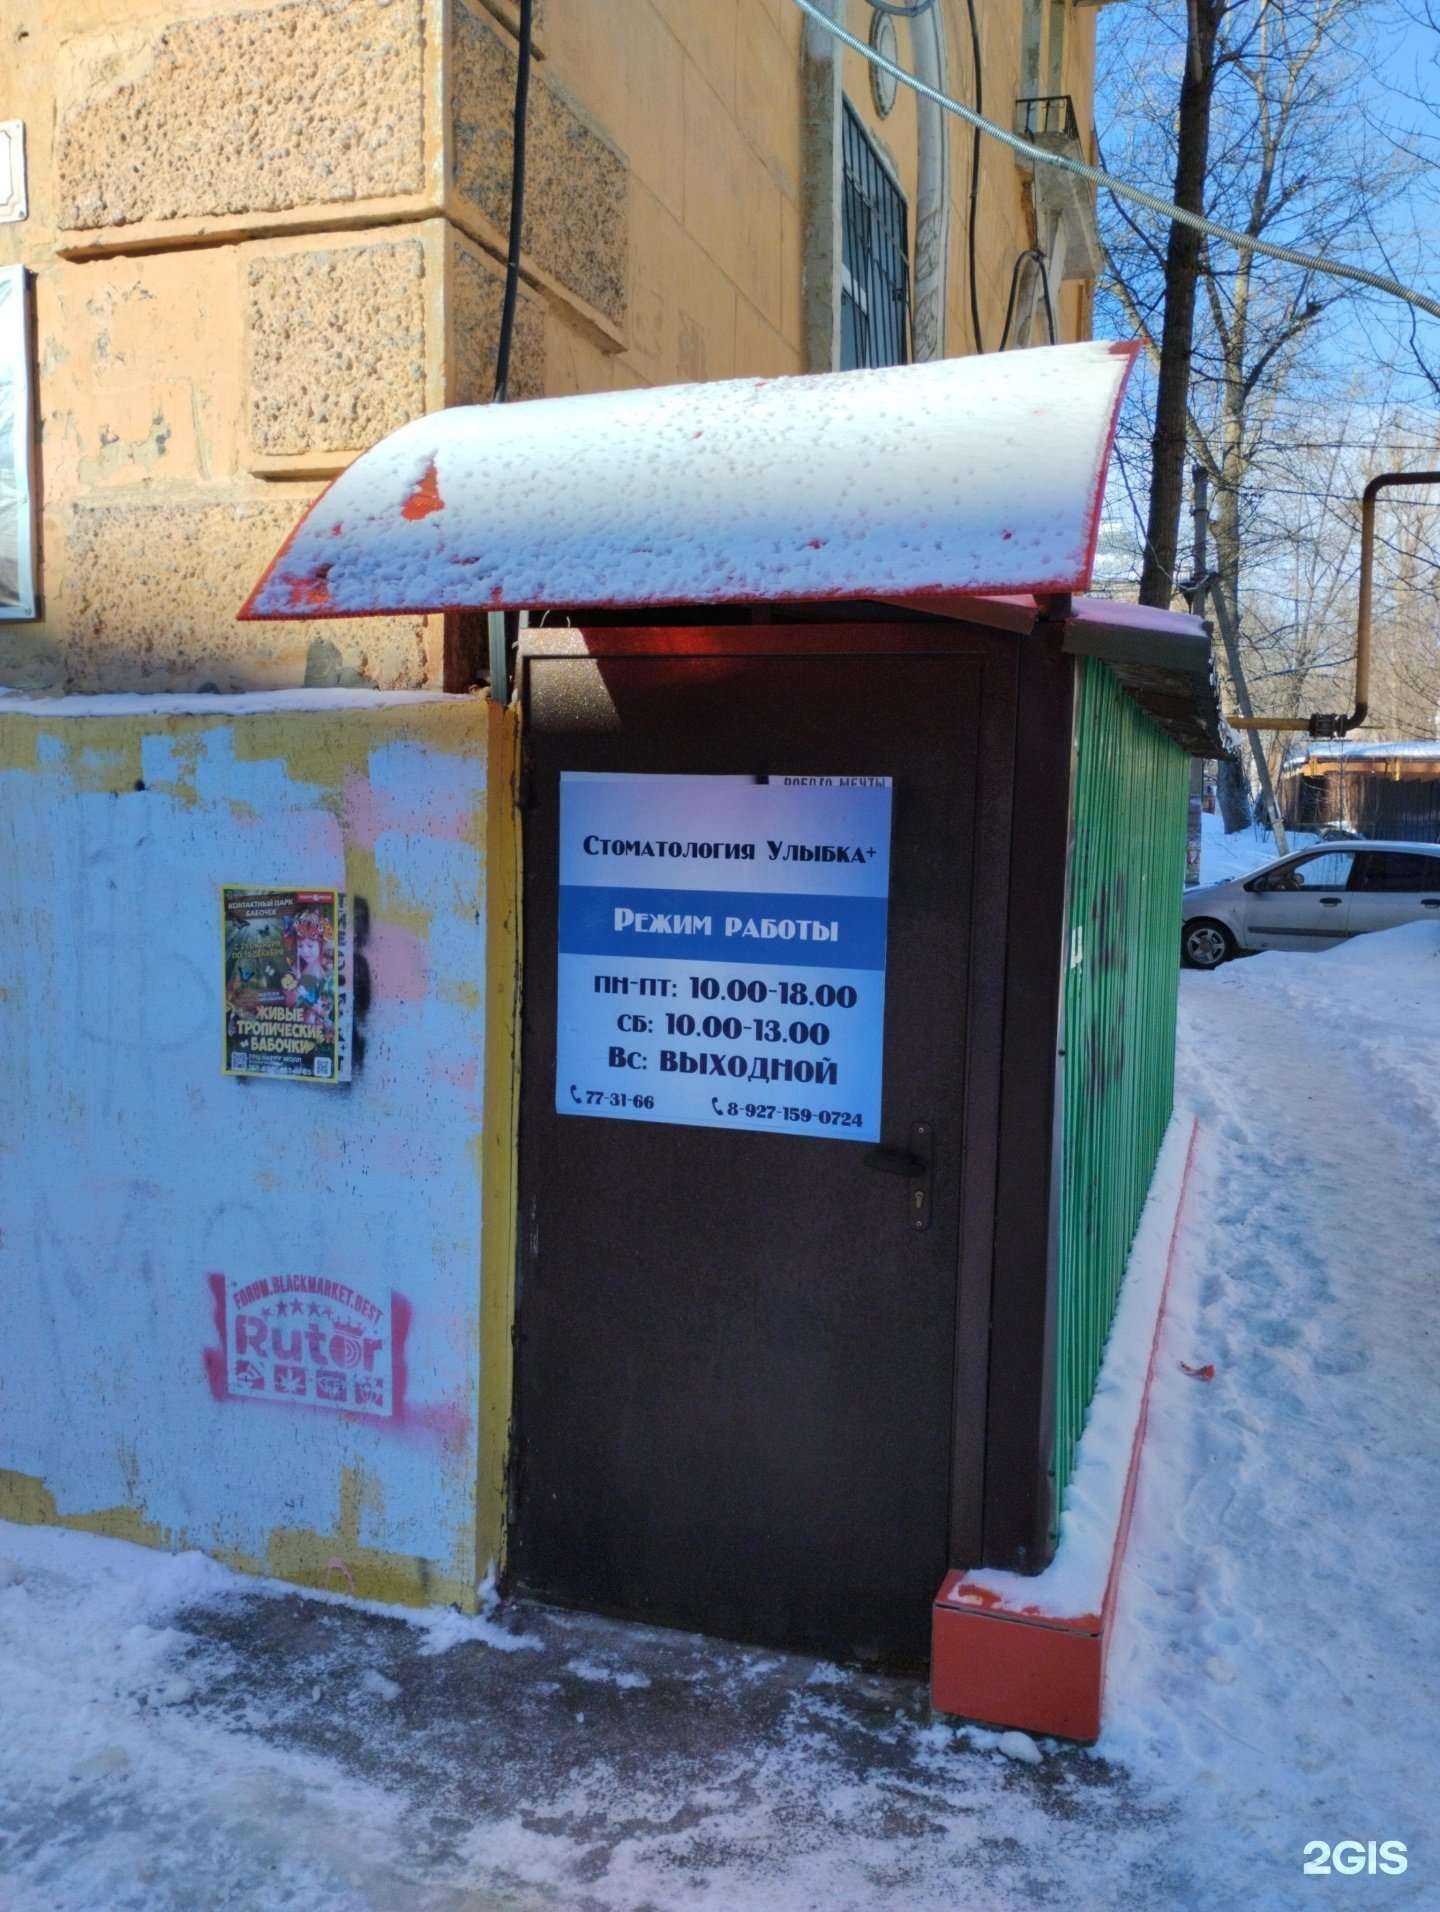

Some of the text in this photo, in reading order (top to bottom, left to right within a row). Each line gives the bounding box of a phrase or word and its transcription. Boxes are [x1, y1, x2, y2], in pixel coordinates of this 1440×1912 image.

[594, 975, 858, 1009] ПН-ПТ: 10.00-18.00
[256, 1005, 305, 1021] ЖИВЫЕ
[236, 1020, 325, 1042] ТРОПИЧЕСКИЕ
[665, 1013, 830, 1046] 10.00-13.00
[250, 1036, 312, 1054] БАБОЧКИ
[659, 1050, 838, 1085] ВЫХОДНОЙ
[585, 1090, 655, 1110] 77-31-66
[727, 1102, 863, 1127] 8-927-159-0724
